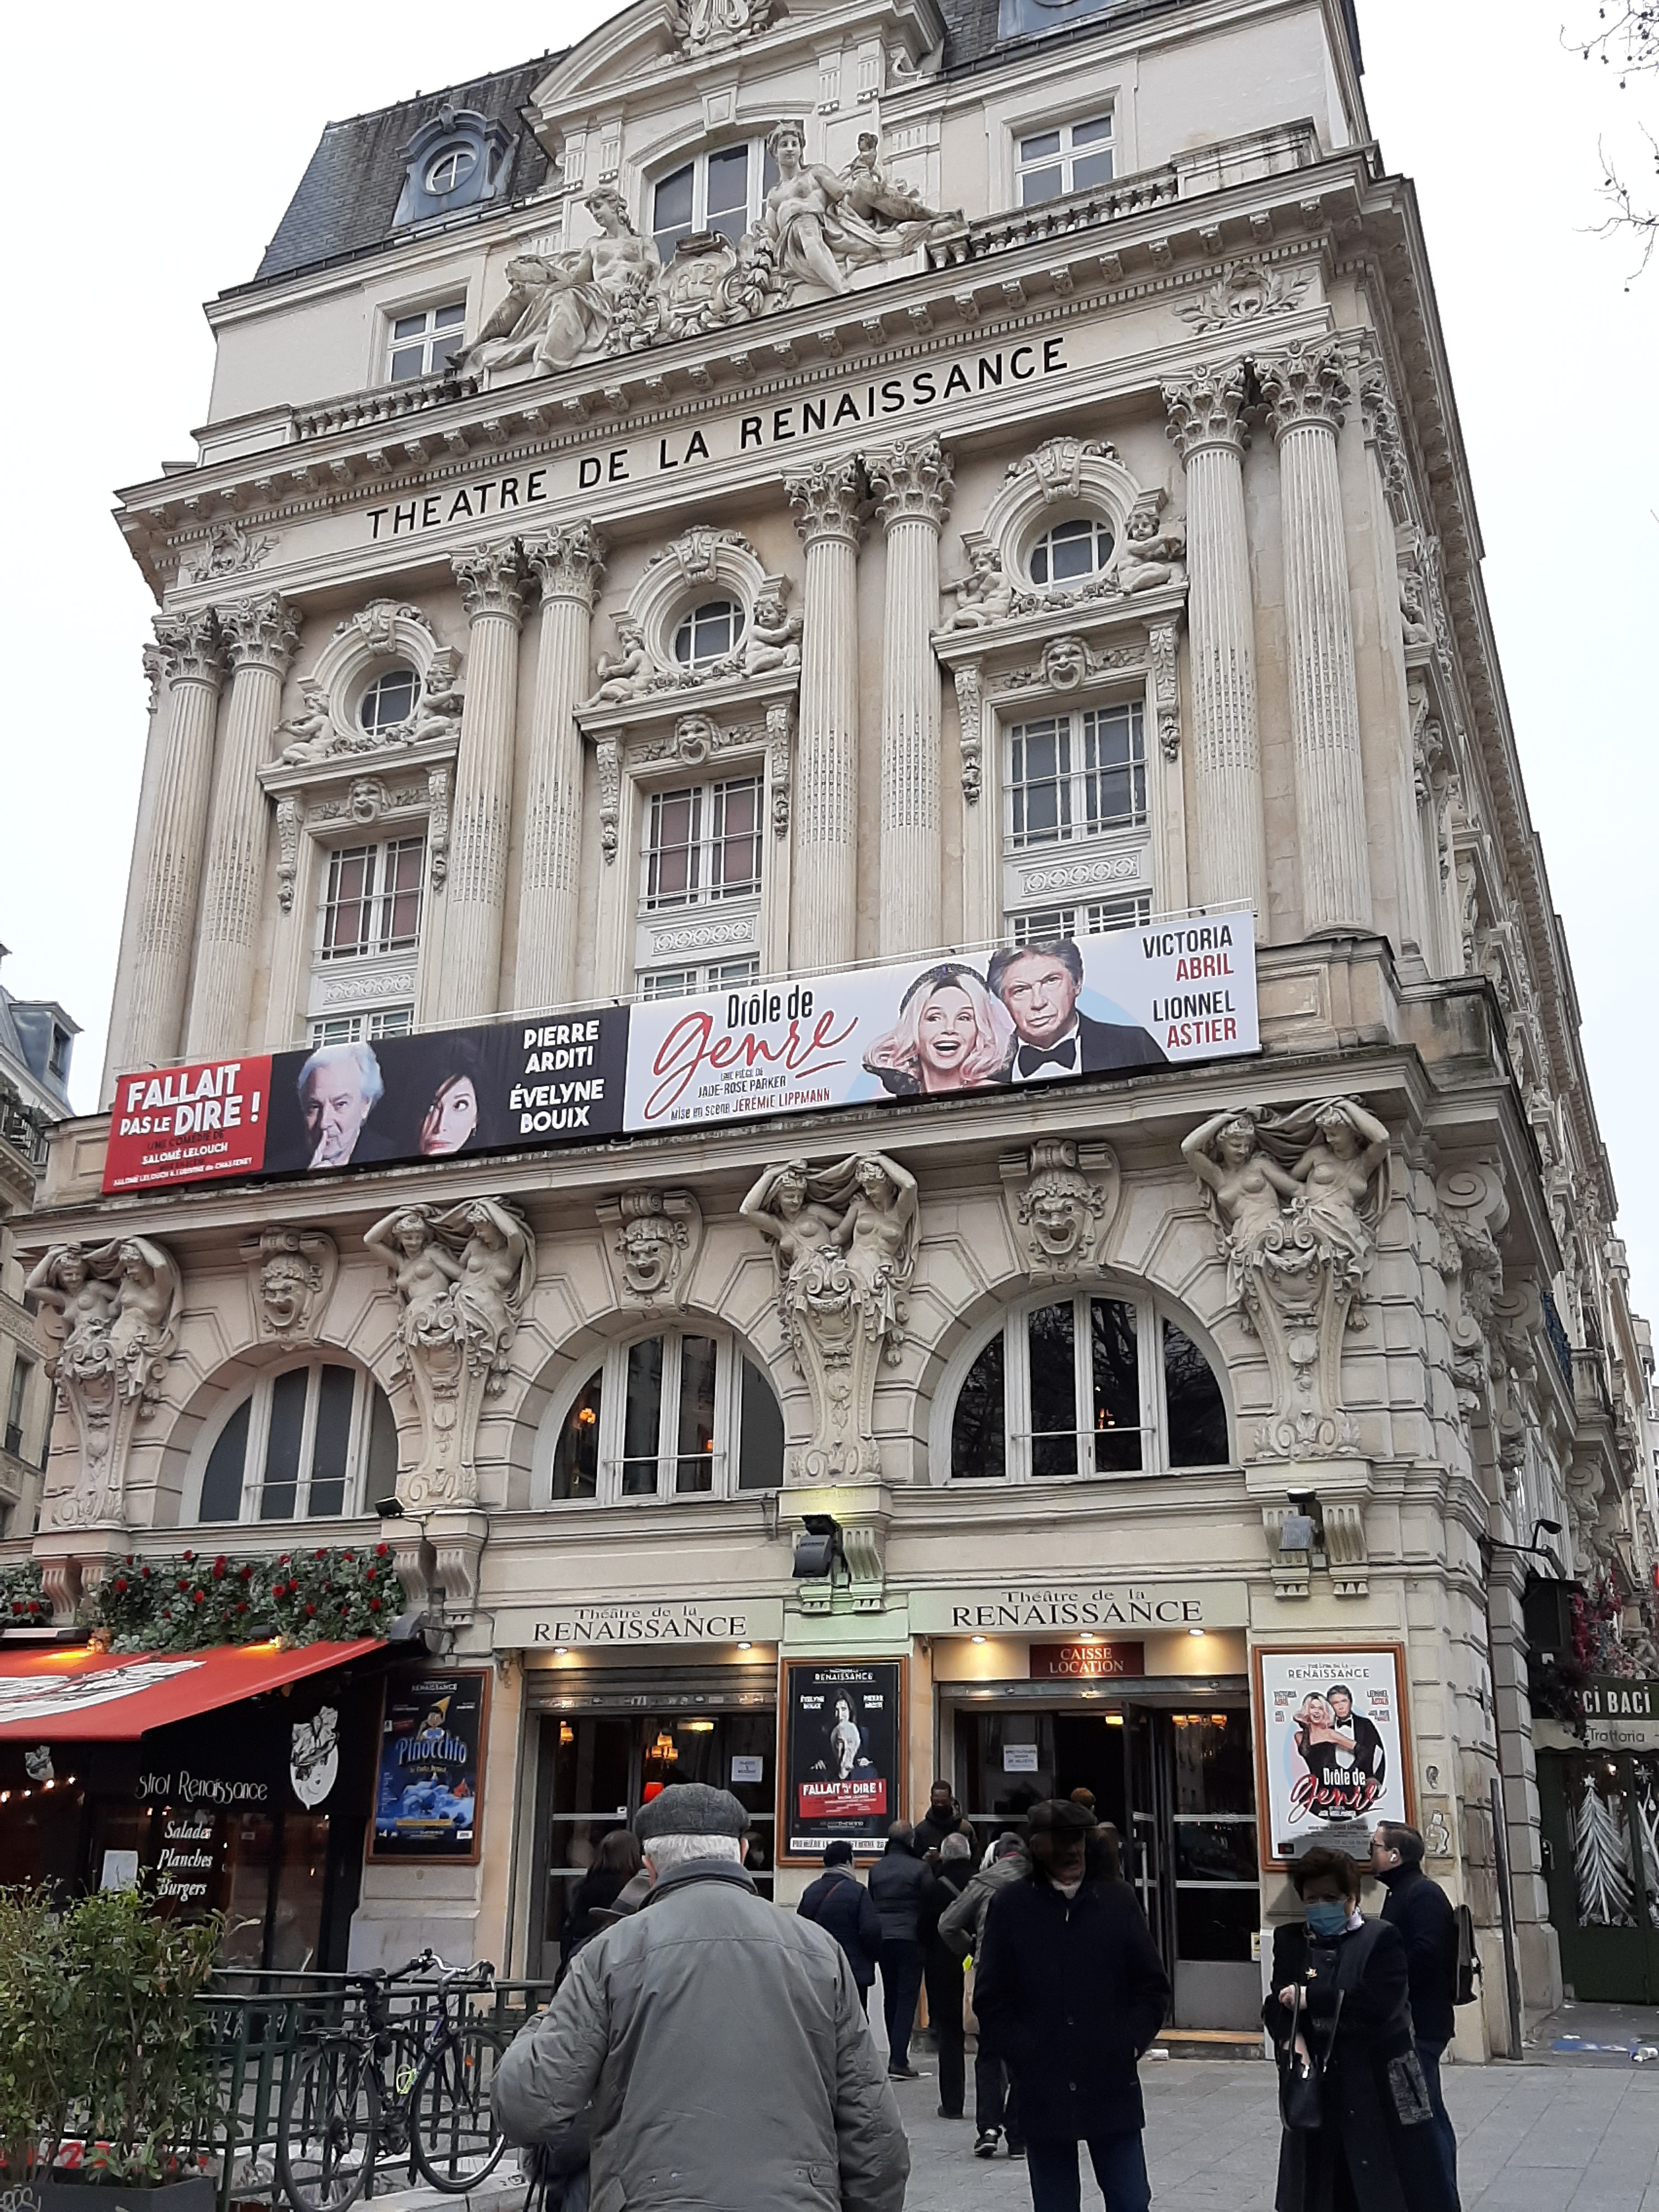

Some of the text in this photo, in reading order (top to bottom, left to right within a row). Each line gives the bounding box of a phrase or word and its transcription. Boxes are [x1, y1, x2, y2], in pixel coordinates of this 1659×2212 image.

[368, 336, 1068, 540] THEATRE DE LA RENAISSANCE
[1143, 926, 1233, 958] VICTORIA
[1176, 953, 1234, 982] ABRIL
[727, 985, 813, 1028] Drôle de
[1153, 990, 1235, 1022] LIONNEL
[523, 1019, 600, 1049] PIERRE
[1166, 1018, 1237, 1048] ASTIER
[524, 1045, 593, 1074] ARDITI
[126, 1063, 241, 1113] FALLAIT
[510, 1078, 604, 1110] ÉVELYNE
[698, 1075, 786, 1098] JADE-ROSE PARKER
[778, 1087, 831, 1107] LIPPMANN
[119, 1091, 261, 1137] PAS LE DIRE !
[520, 1105, 590, 1134] BOUIX
[182, 1142, 228, 1158] LELOUCH
[1001, 1589, 1145, 1602] Théâtre de la
[652, 1606, 671, 1617] de
[682, 1605, 697, 1616] la
[952, 1600, 1203, 1627] RENAISSANCE
[533, 1616, 747, 1642] RENAISSANCE
[1049, 1660, 1124, 1674] LOCATION
[1060, 1647, 1112, 1661] CAISSE
[815, 1672, 873, 1681] RENAISSANCE
[1288, 1668, 1369, 1678] RENAISSANCE
[396, 1730, 467, 1765] Pinocchio
[1588, 1728, 1645, 1742] Trattoria
[178, 1770, 268, 1804] Renaissance
[803, 1782, 841, 1796] FALLAIT
[853, 1782, 877, 1795] DIRE
[1323, 1767, 1366, 1786] Drôle de
[165, 1820, 212, 1839] Salades
[157, 1848, 213, 1870] Planches
[157, 1878, 207, 1902] Burgers
